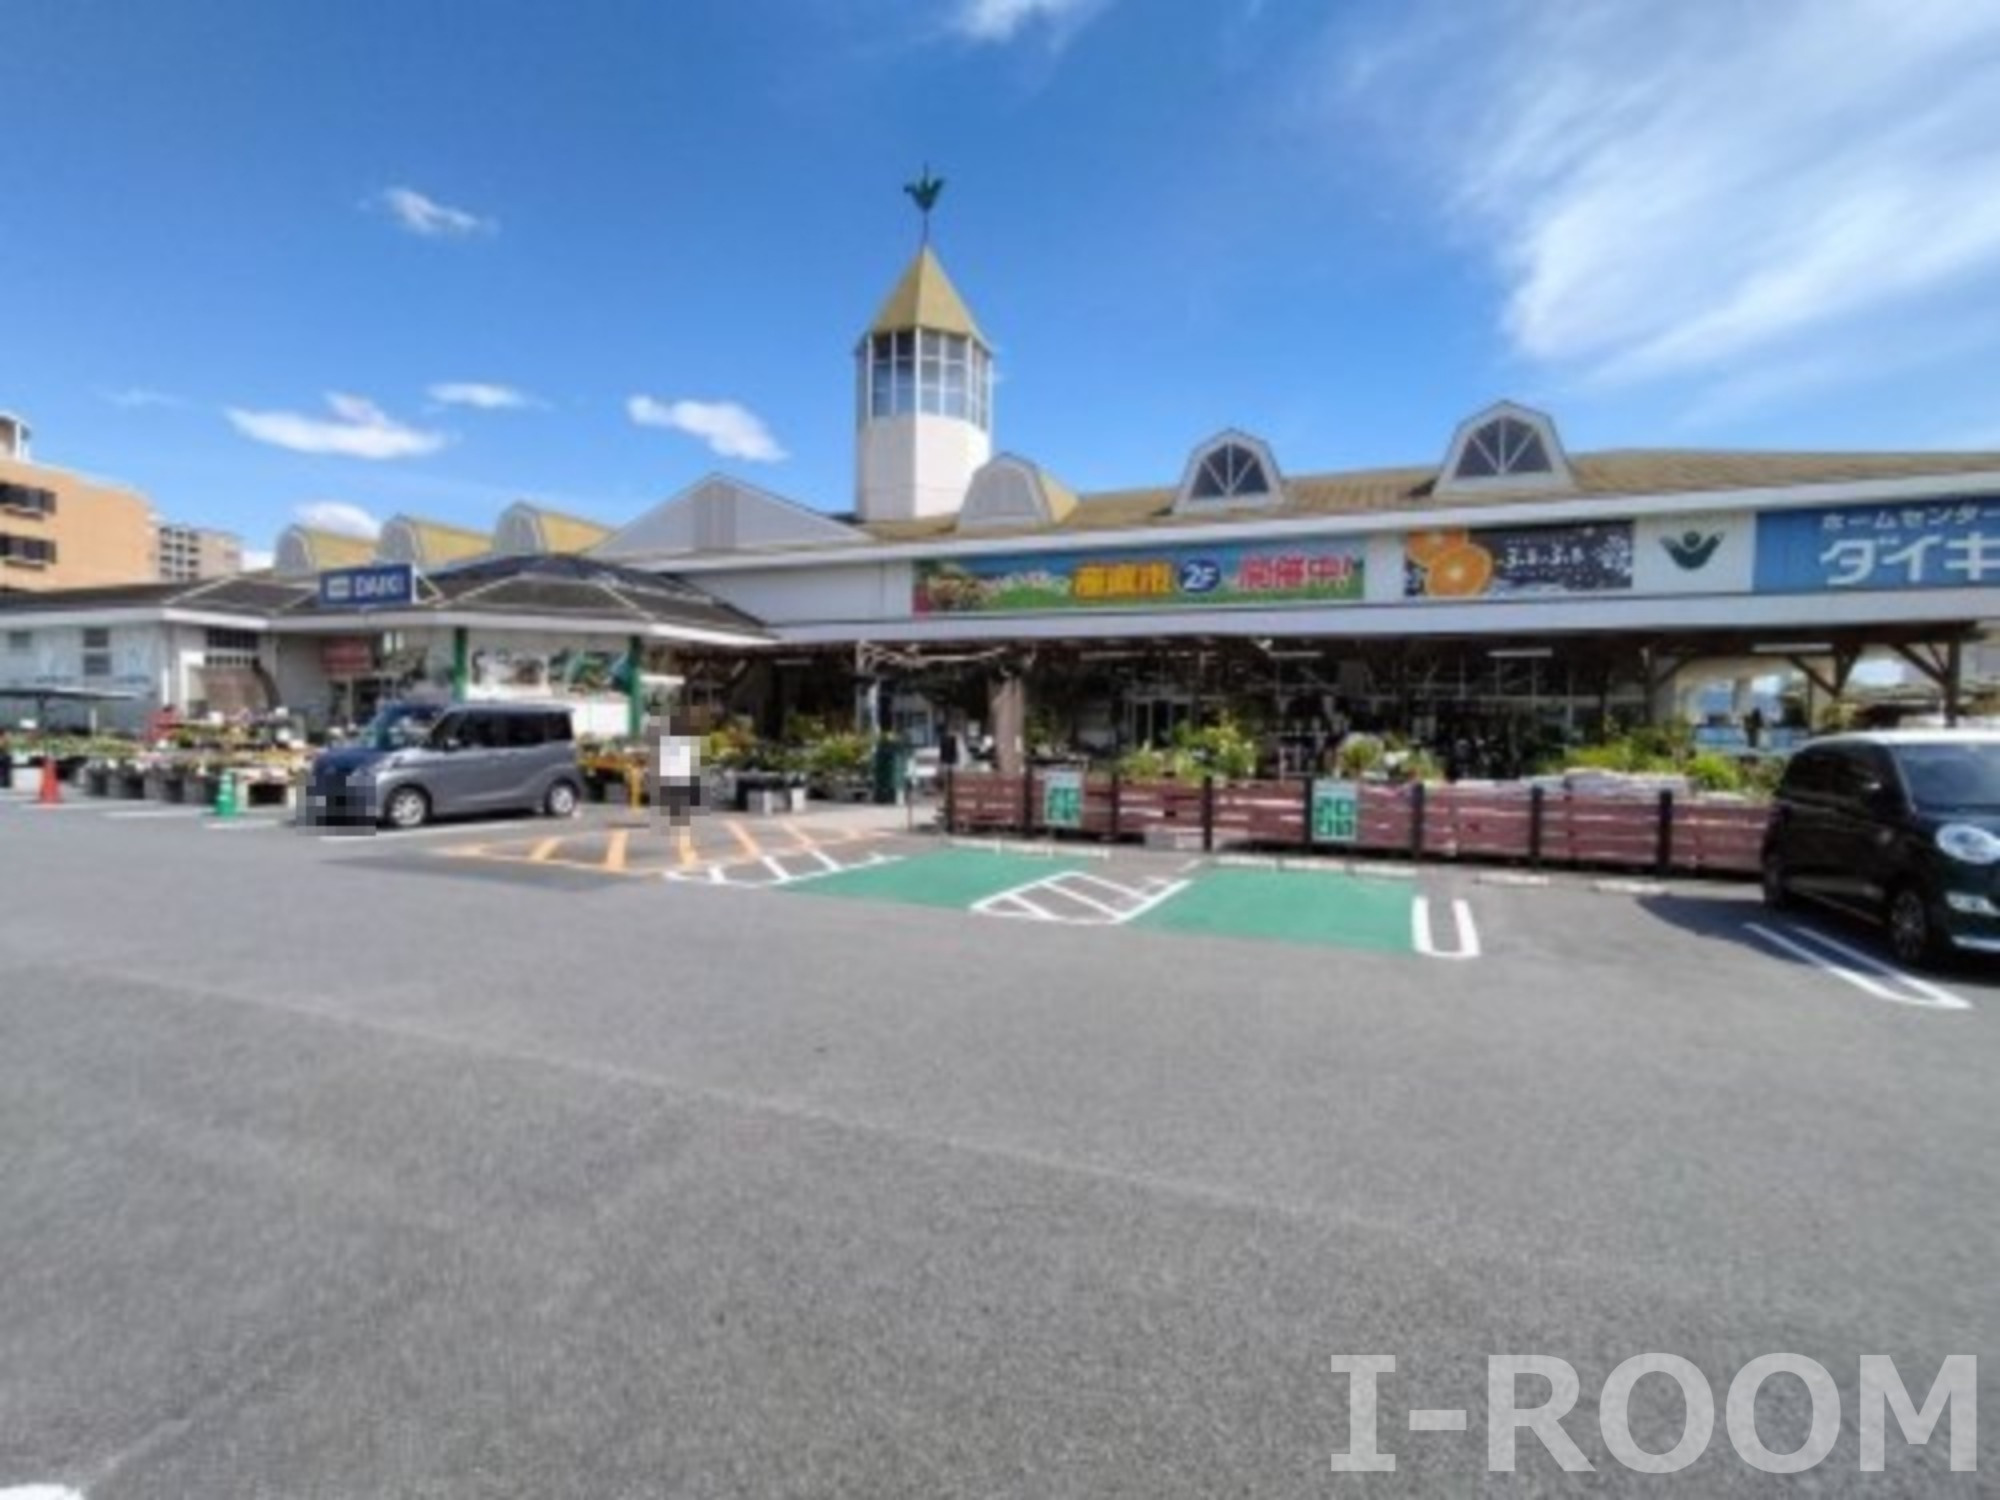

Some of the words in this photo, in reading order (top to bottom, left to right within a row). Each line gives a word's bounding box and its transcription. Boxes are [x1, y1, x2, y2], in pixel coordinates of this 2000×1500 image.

[1822, 505, 2000, 530] ホームセンター
[1819, 531, 2000, 586] ダイキ
[1183, 563, 1217, 589] 2F
